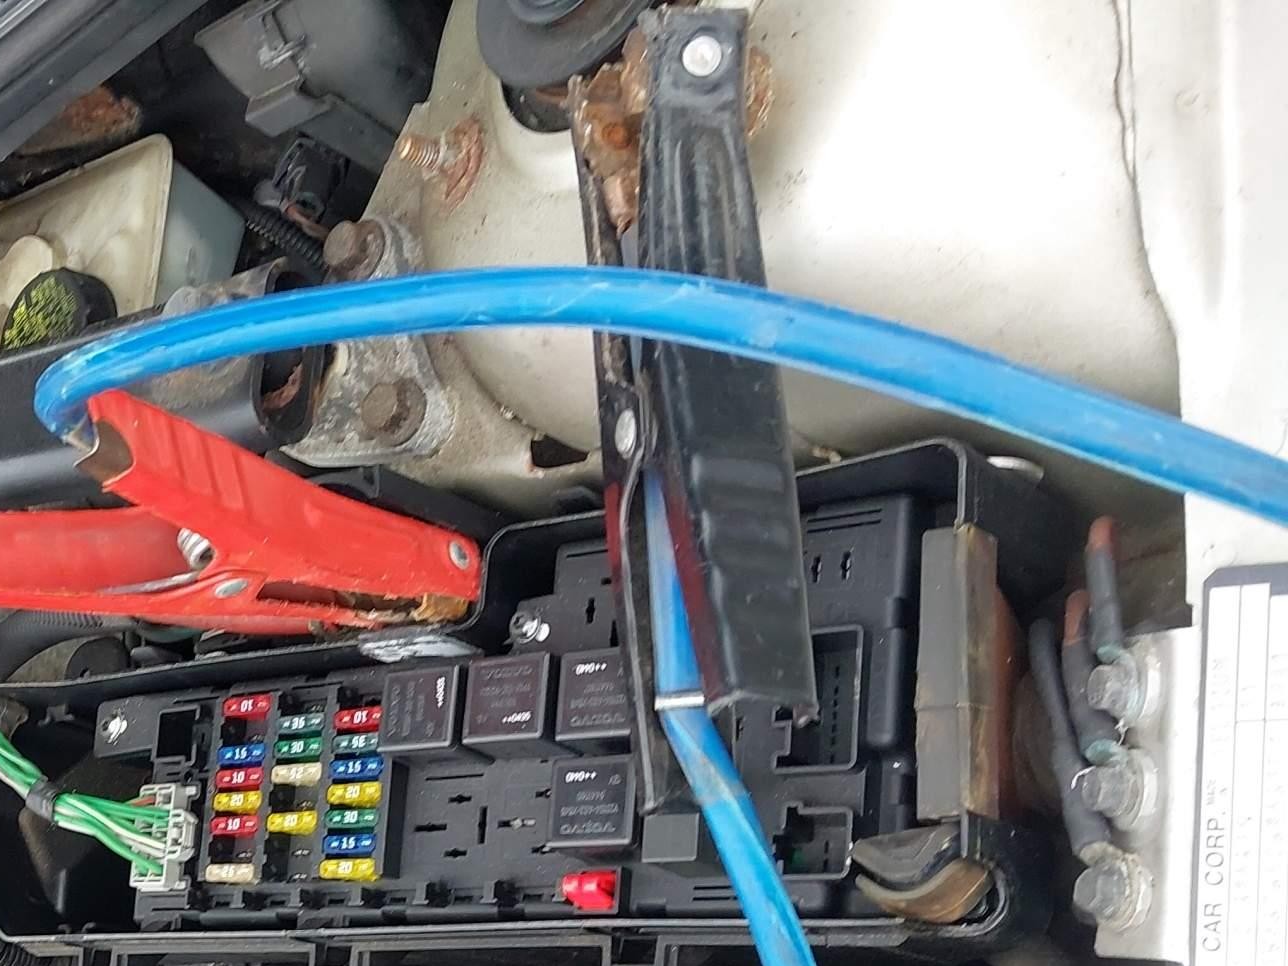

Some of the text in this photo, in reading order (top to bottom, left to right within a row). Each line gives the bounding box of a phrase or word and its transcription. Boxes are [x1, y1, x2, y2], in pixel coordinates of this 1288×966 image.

[231, 771, 245, 784] 10
[226, 817, 241, 830] 10
[1202, 810, 1227, 887] CORP.
[1201, 902, 1223, 953] CAR
